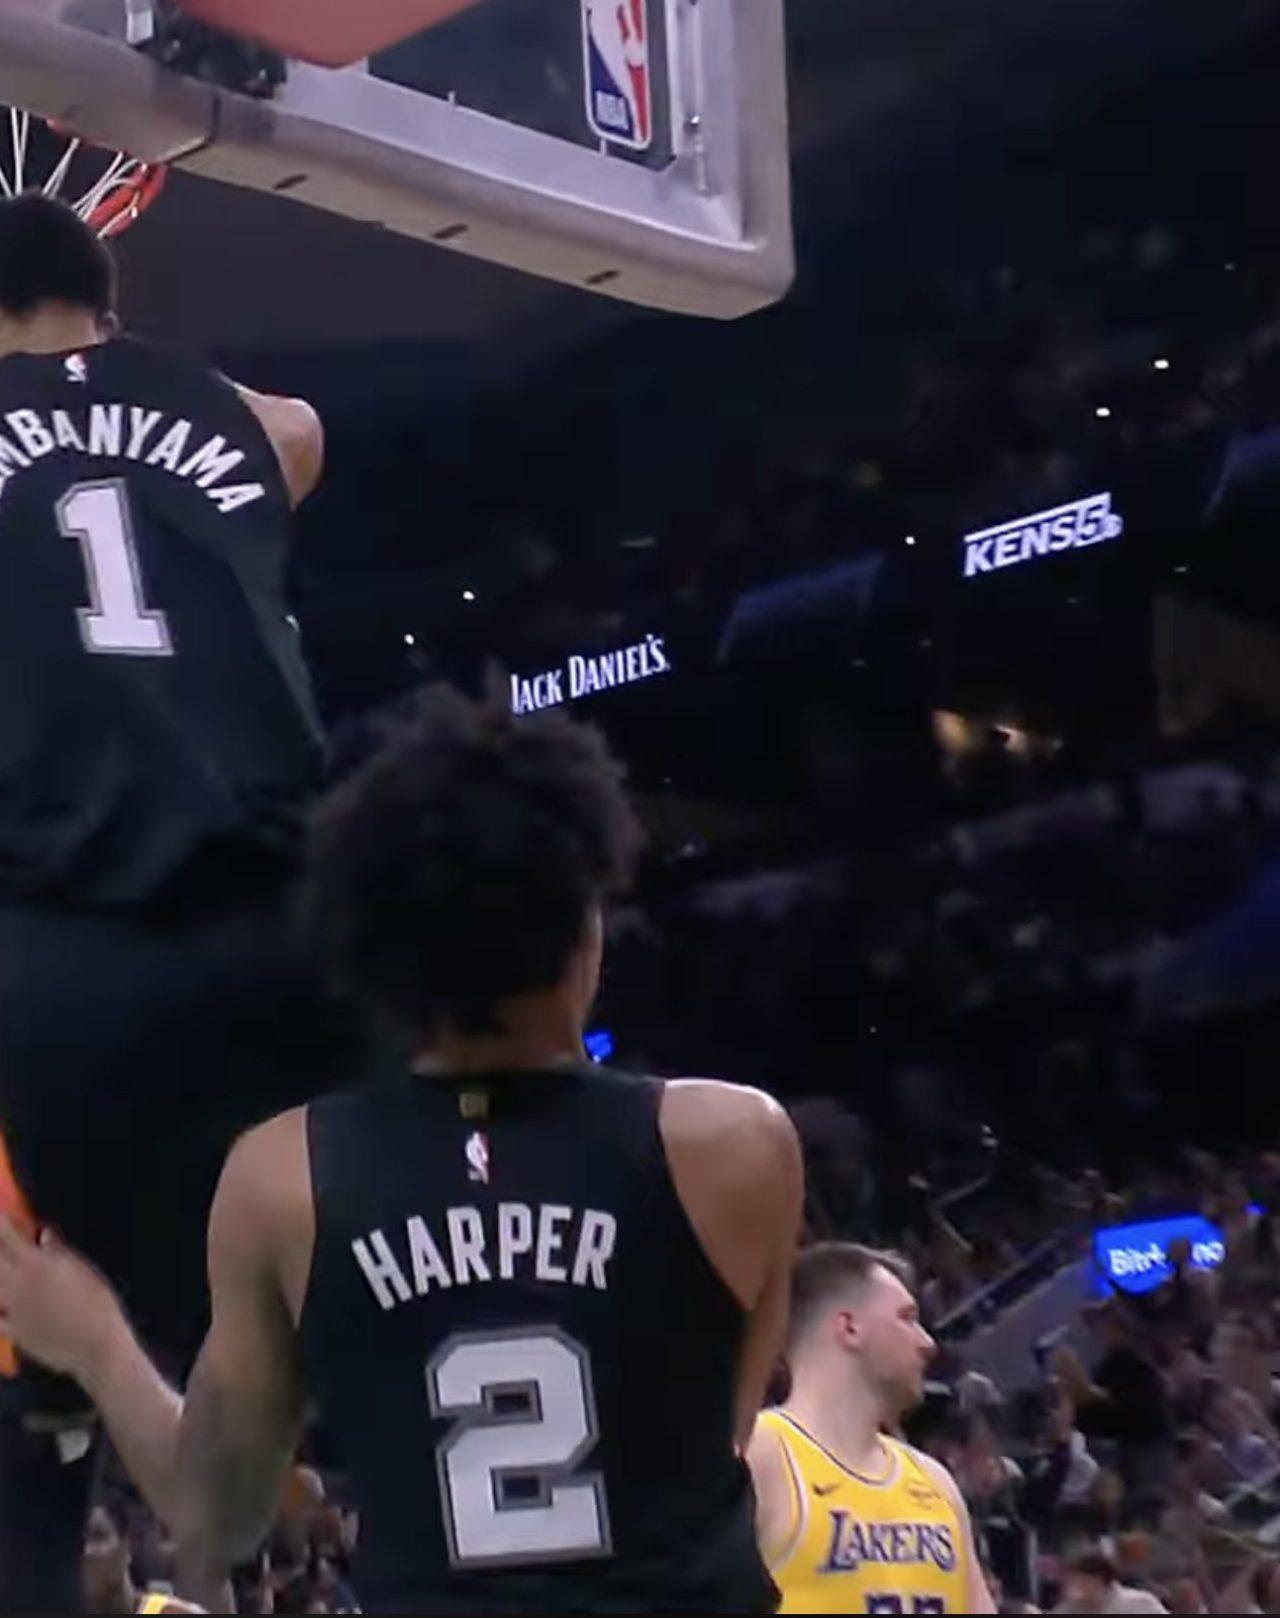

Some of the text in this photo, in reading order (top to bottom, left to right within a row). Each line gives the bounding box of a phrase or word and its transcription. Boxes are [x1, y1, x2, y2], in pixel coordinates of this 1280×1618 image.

[54, 476, 174, 656] 1
[510, 668, 564, 715] JACK
[350, 1202, 618, 1311] HARPER
[426, 1324, 613, 1571] 2
[817, 1510, 957, 1573] LAKERS
